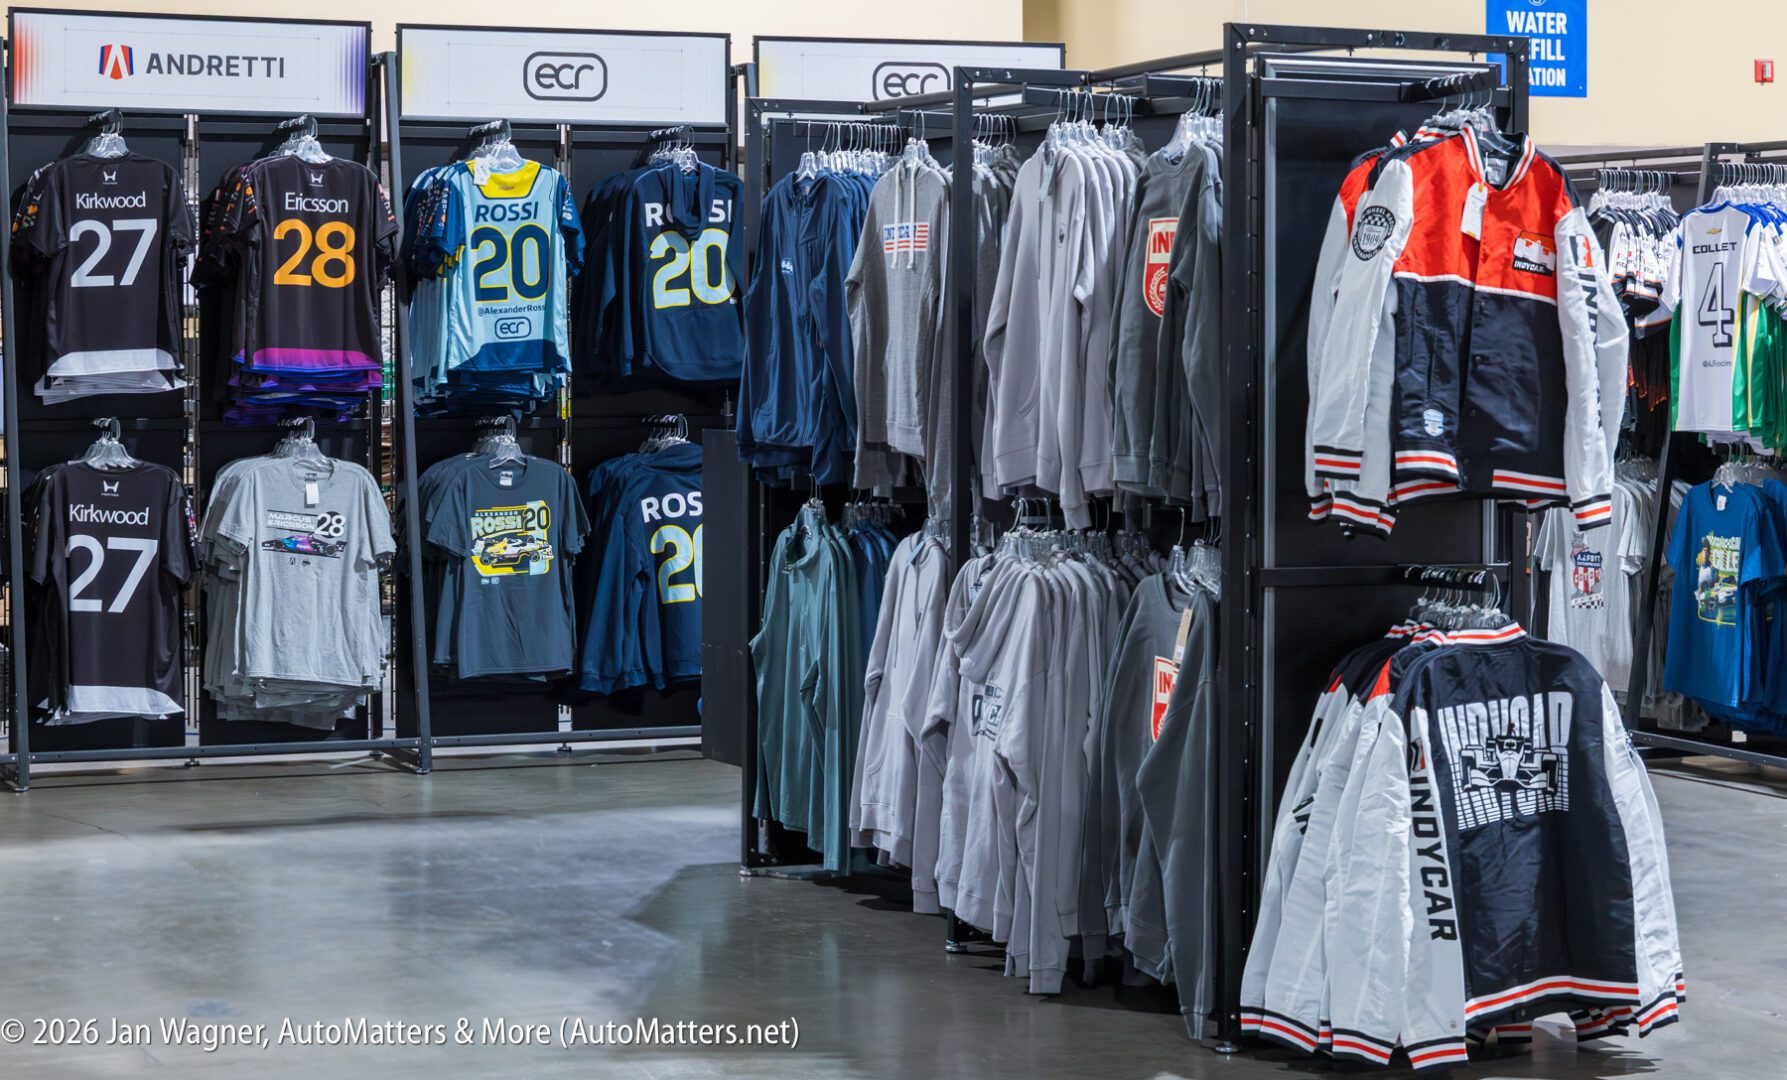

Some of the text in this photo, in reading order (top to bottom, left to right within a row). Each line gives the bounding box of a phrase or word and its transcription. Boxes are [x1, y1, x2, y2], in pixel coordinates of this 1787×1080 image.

[1506, 11, 1567, 34] WATER
[1528, 38, 1566, 61] FILL
[146, 53, 285, 78] ANDRETTI
[535, 63, 594, 90] ecr
[1528, 67, 1566, 86] ATION
[883, 72, 939, 95] ecr
[76, 192, 146, 209] Kirkwood
[285, 192, 348, 214] Ericsson
[474, 202, 539, 223] ROSSI
[644, 199, 732, 227] RSI
[69, 218, 158, 287] 27
[273, 218, 357, 288] 28
[1692, 242, 1737, 254] COLLET
[470, 222, 549, 301] 20
[650, 228, 735, 309] 20
[478, 304, 546, 316] @AlexanderRoss
[1698, 262, 1735, 348] 4
[500, 321, 525, 334] ecr
[69, 504, 149, 526] Kirkwood
[268, 513, 311, 523] MARCUS
[641, 491, 703, 523] ROS
[267, 520, 315, 530] ERICSSON
[315, 513, 346, 537] 28
[470, 506, 551, 540] ROSSI 20
[65, 534, 158, 613] 27
[650, 524, 703, 605] 2
[1411, 776, 1458, 942] INDYCAR
